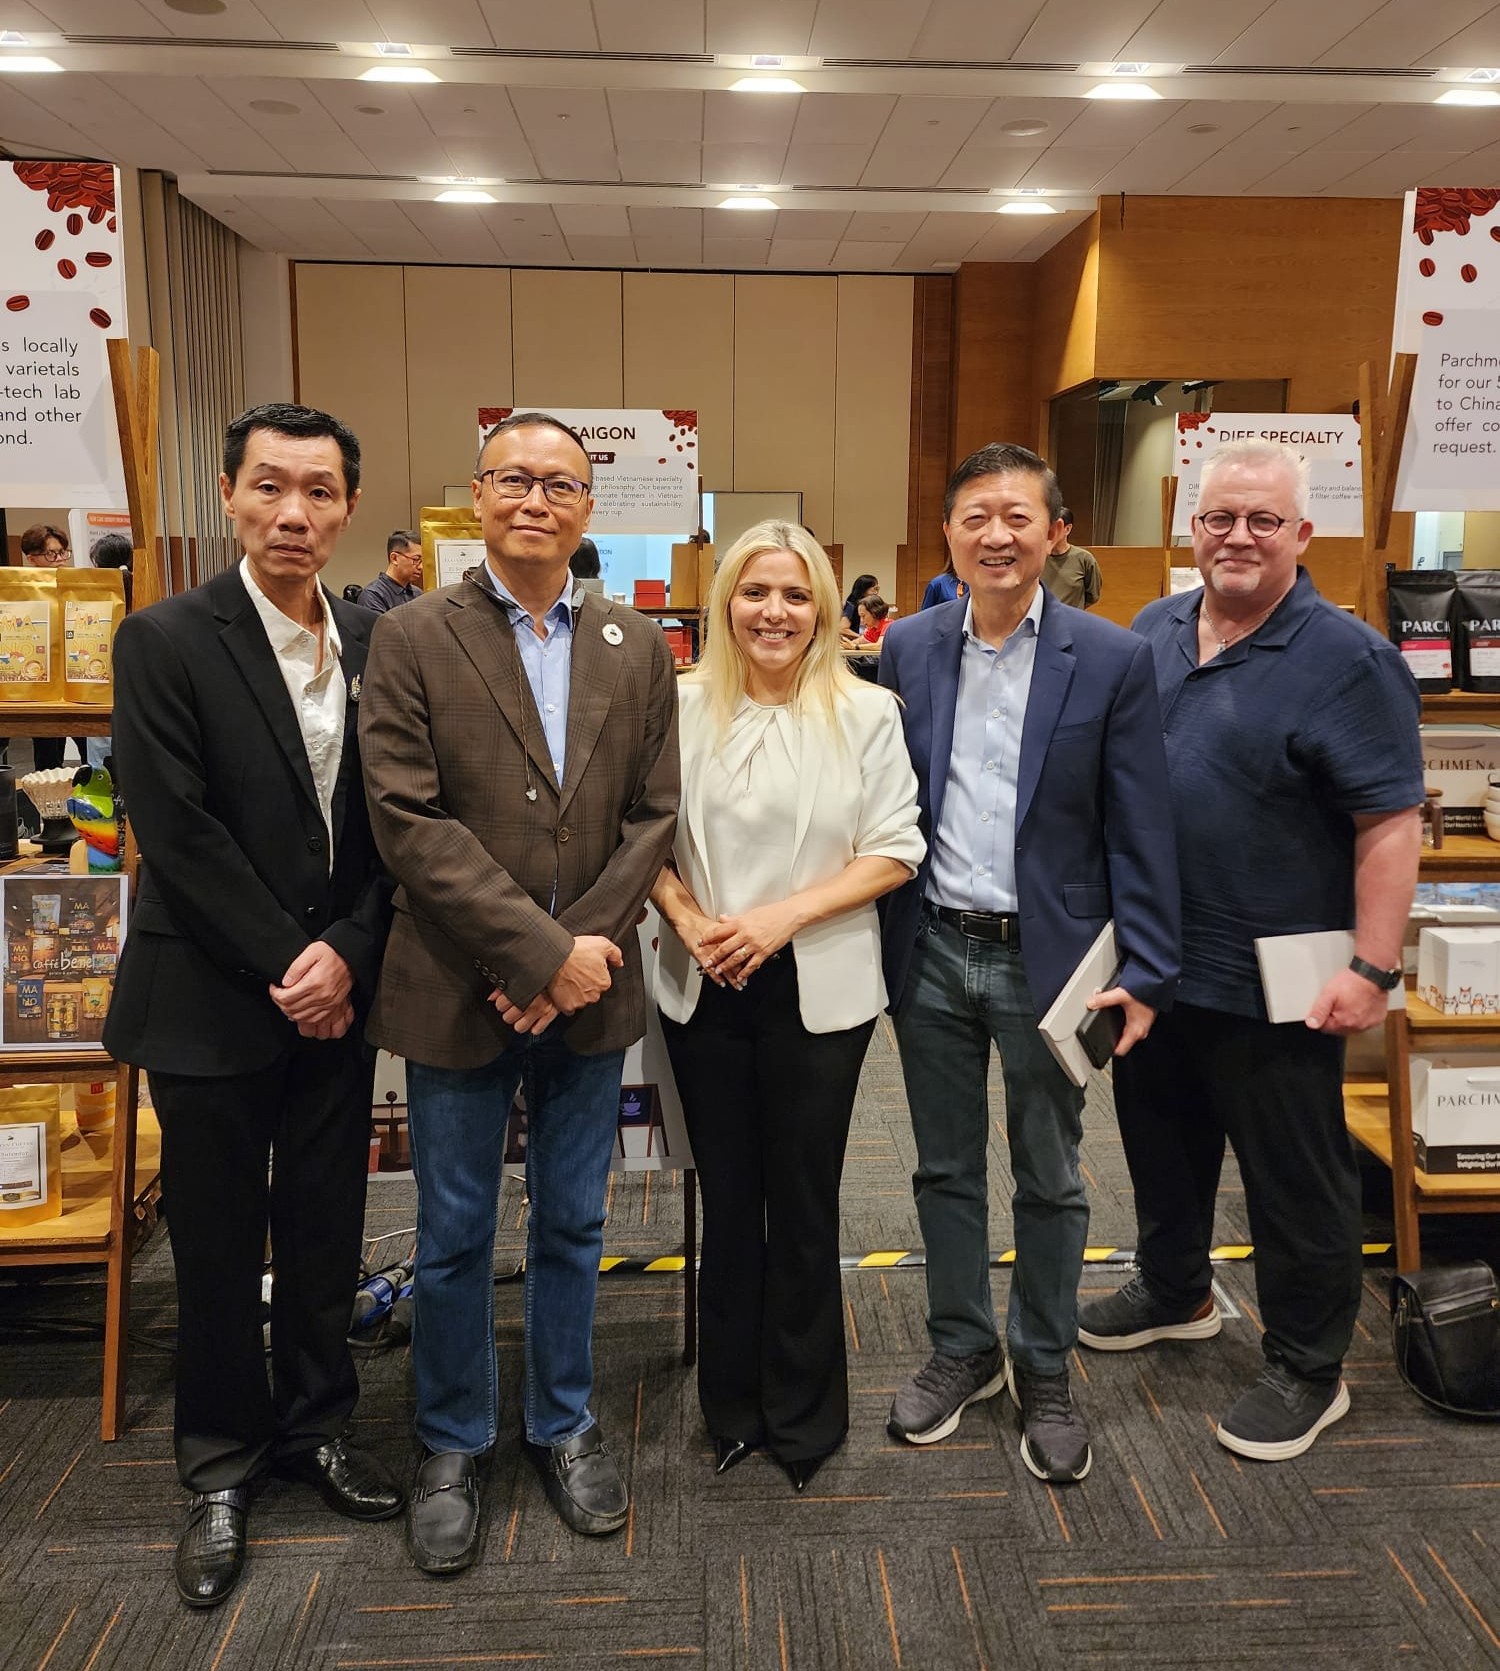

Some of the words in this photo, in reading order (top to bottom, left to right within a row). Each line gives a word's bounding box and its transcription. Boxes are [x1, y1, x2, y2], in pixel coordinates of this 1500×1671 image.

[23, 337, 78, 357] locally
[1441, 353, 1500, 368] Parchm
[6, 361, 80, 376] varietals
[1438, 374, 1460, 389] for
[1466, 378, 1492, 389] our
[54, 384, 81, 400] lab
[1437, 399, 1453, 410] to
[34, 406, 82, 422] other
[1435, 417, 1472, 432] offer
[1260, 431, 1344, 443] SPECIALTY
[1433, 441, 1497, 456] request.
[656, 475, 682, 483] specialty
[600, 500, 636, 508] celebrating
[22, 985, 38, 994] MA
